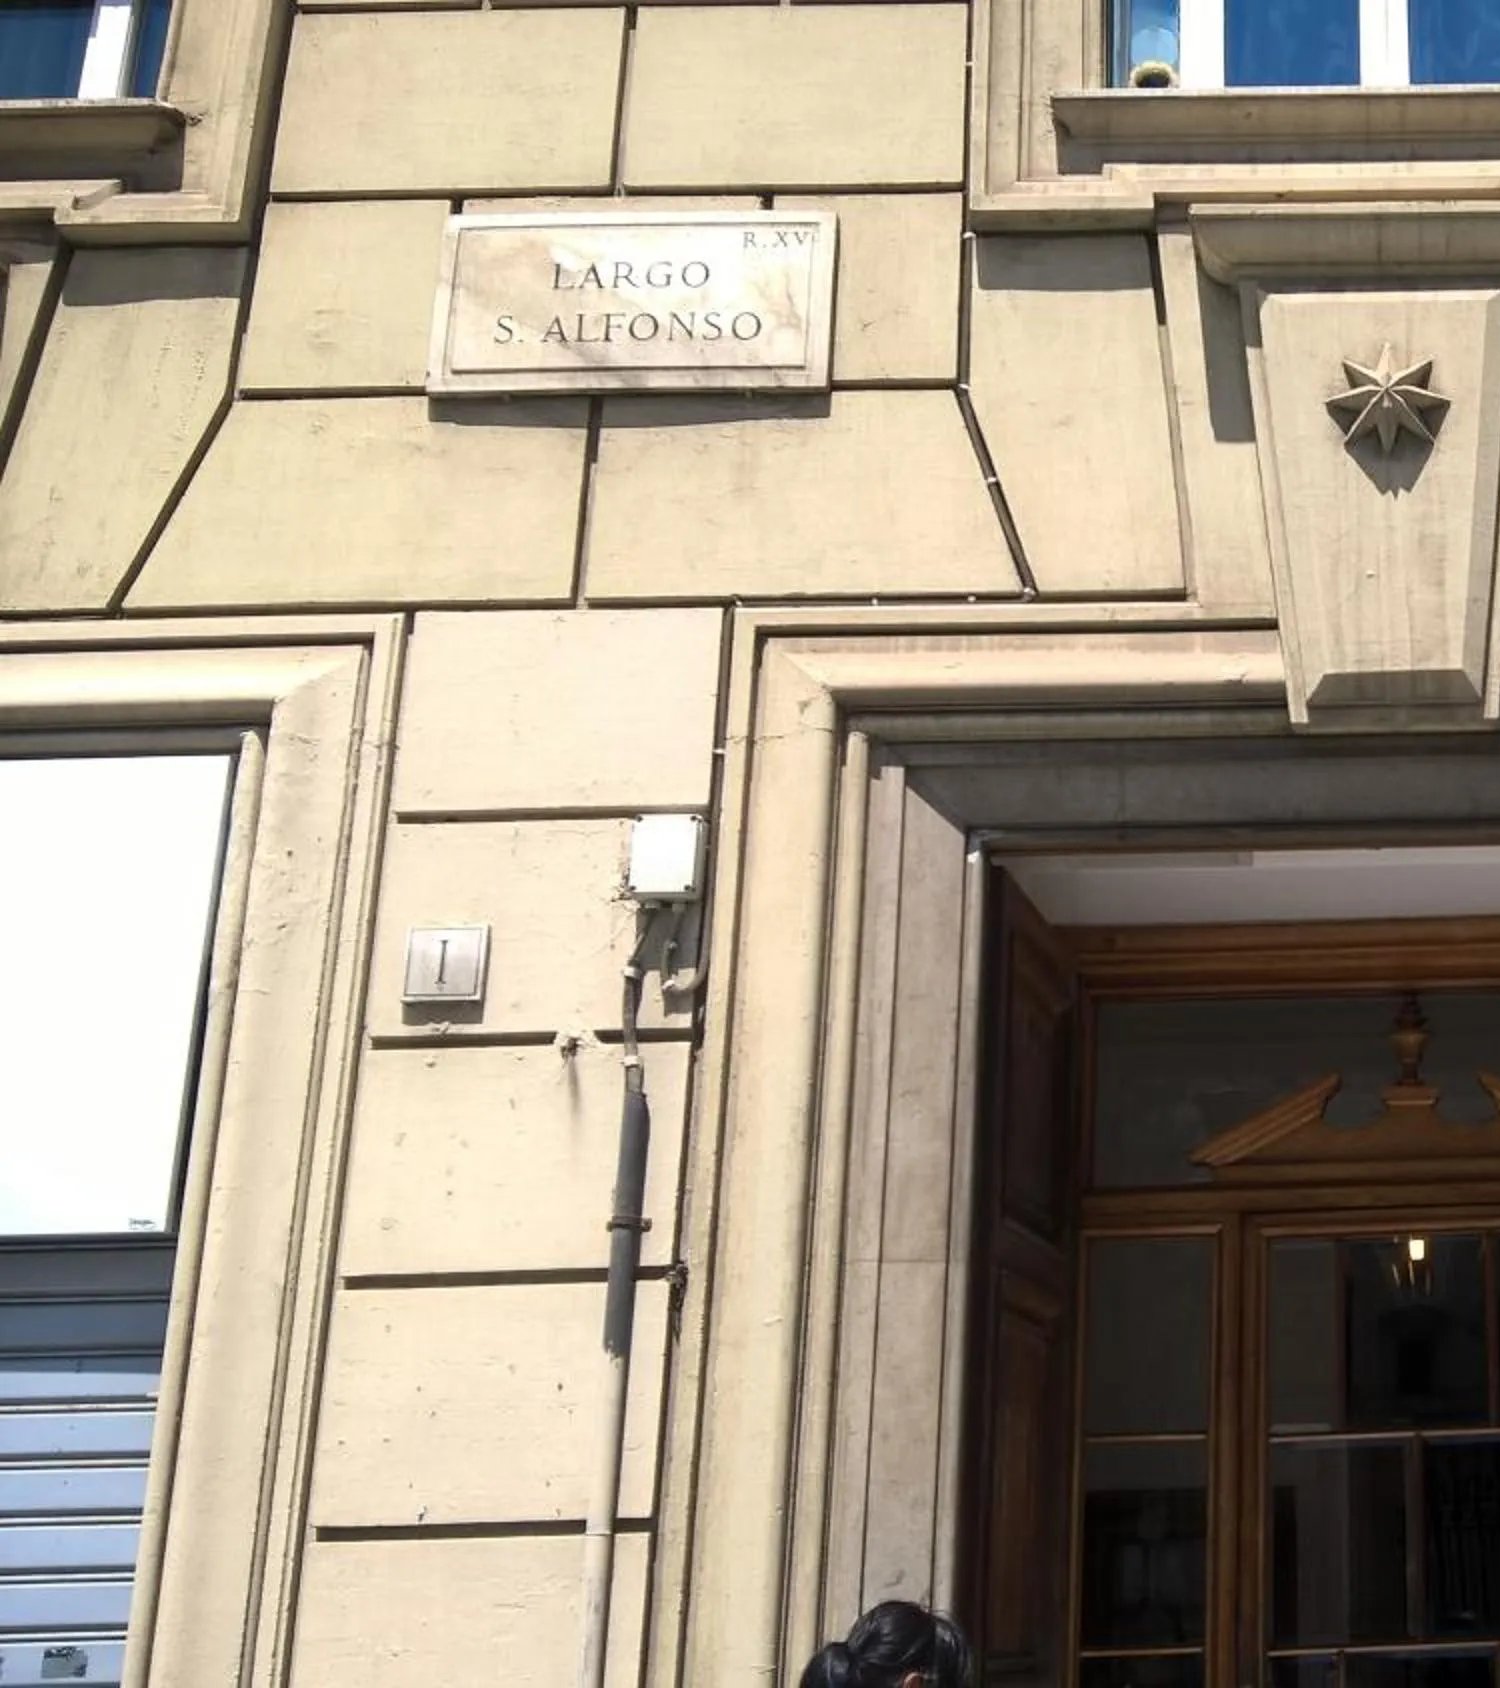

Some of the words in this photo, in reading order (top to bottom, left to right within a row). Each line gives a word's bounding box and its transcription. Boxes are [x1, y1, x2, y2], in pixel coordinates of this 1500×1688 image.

[552, 260, 711, 291] LARGO
[493, 314, 524, 345] S.
[541, 311, 764, 344] ALFONSO
